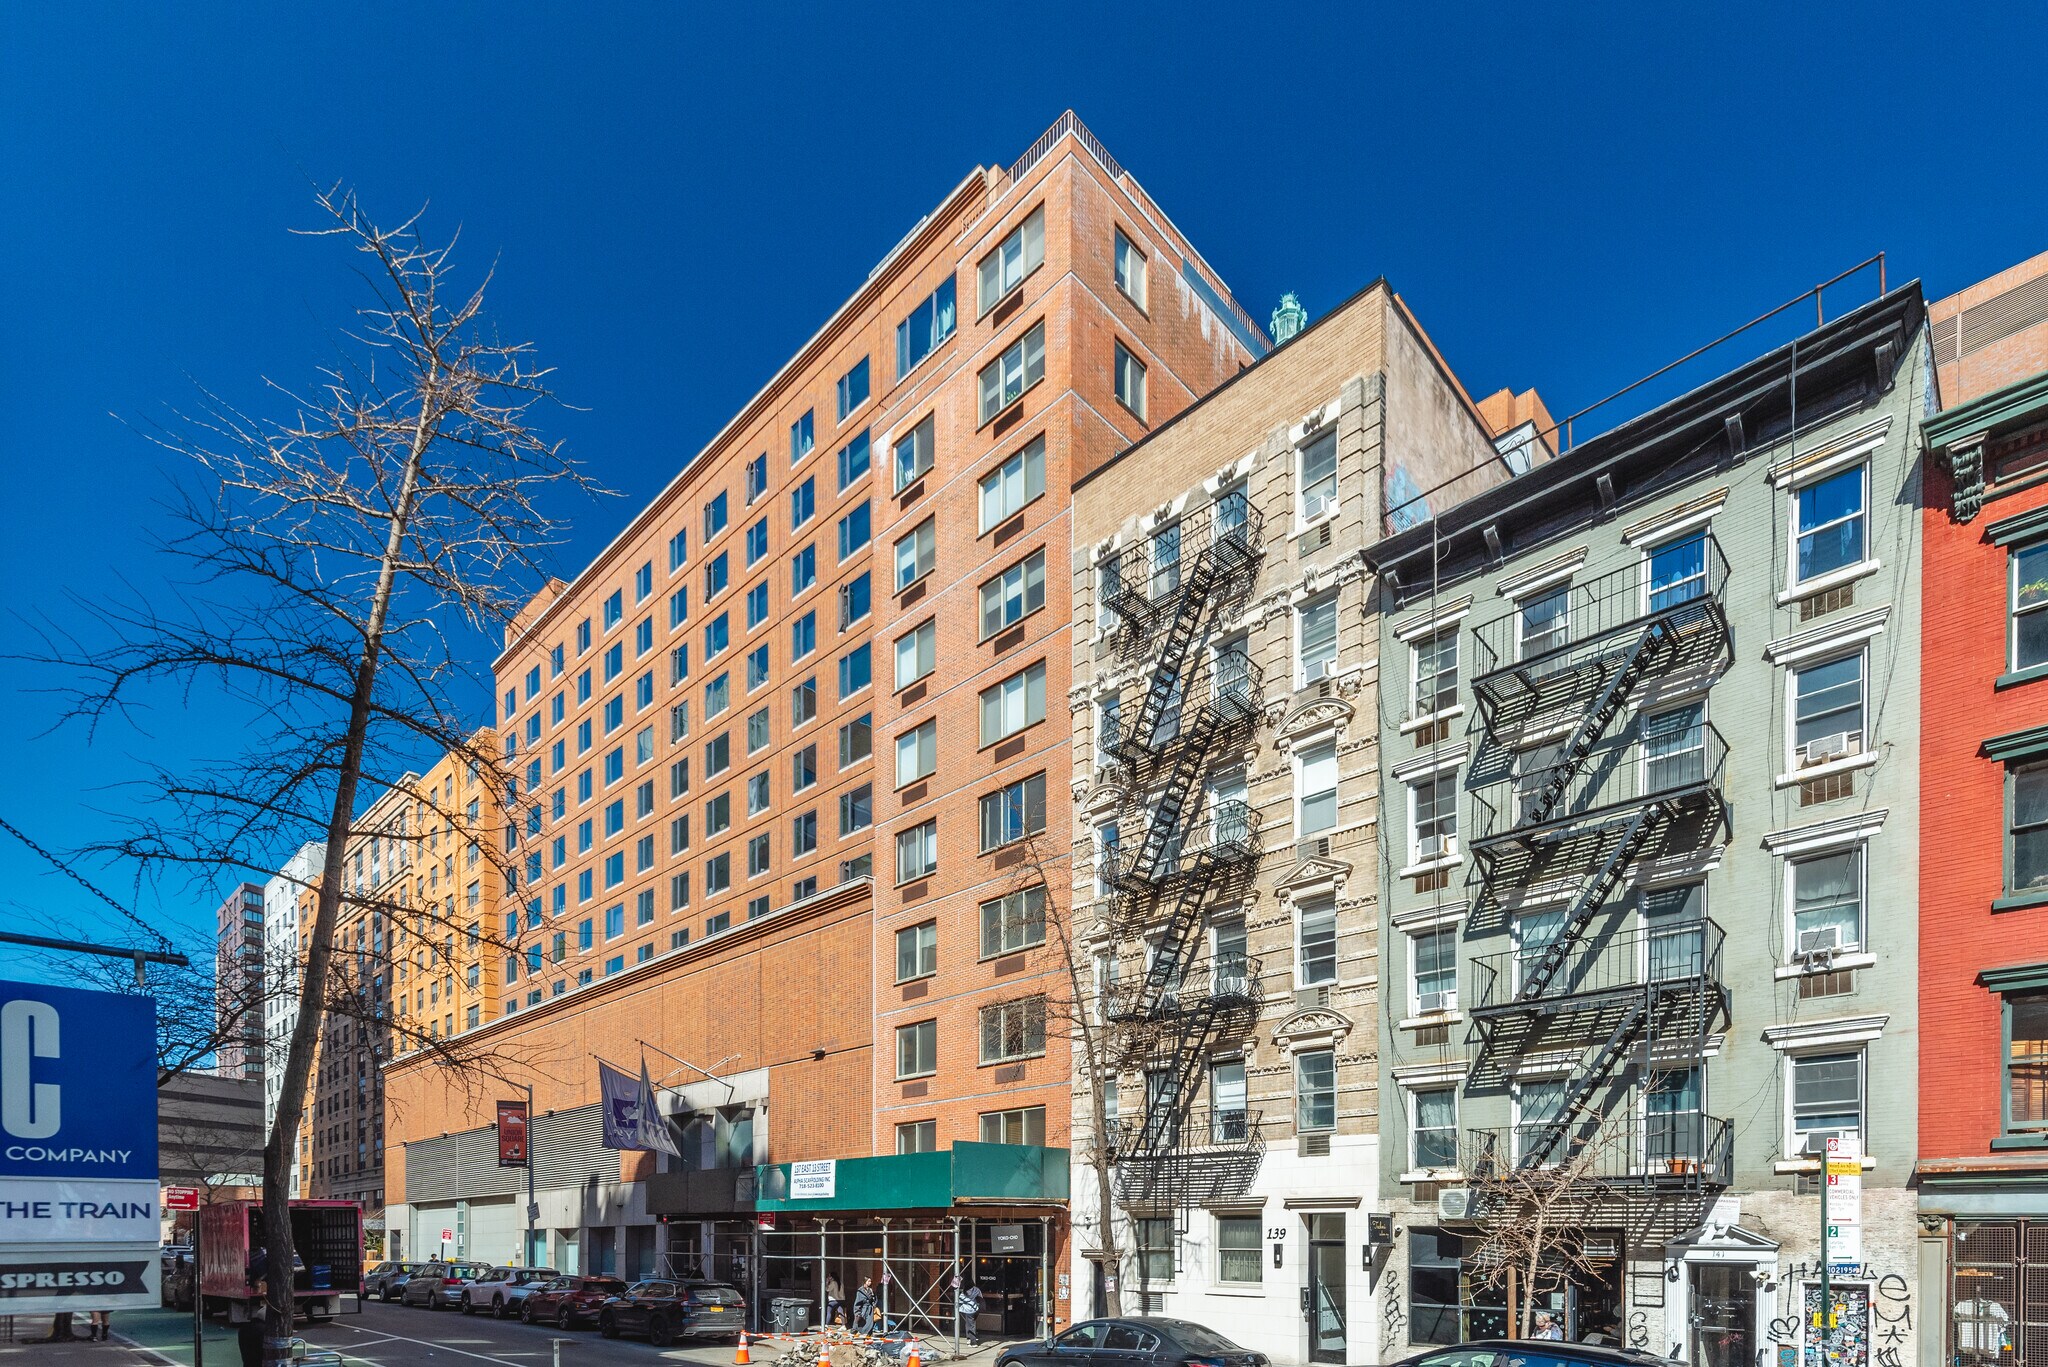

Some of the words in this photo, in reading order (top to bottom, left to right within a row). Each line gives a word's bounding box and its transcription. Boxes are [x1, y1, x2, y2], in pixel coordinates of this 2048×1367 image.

[1, 1000, 61, 1139] C
[501, 1135, 525, 1143] SQUARE
[5, 1146, 132, 1164] COMPANY
[1829, 1176, 1837, 1185] 3
[58, 1202, 151, 1219] TRAIN
[1266, 1228, 1287, 1240] 139
[1830, 1226, 1837, 1237] 2
[0, 1270, 126, 1289] SPRESSO
